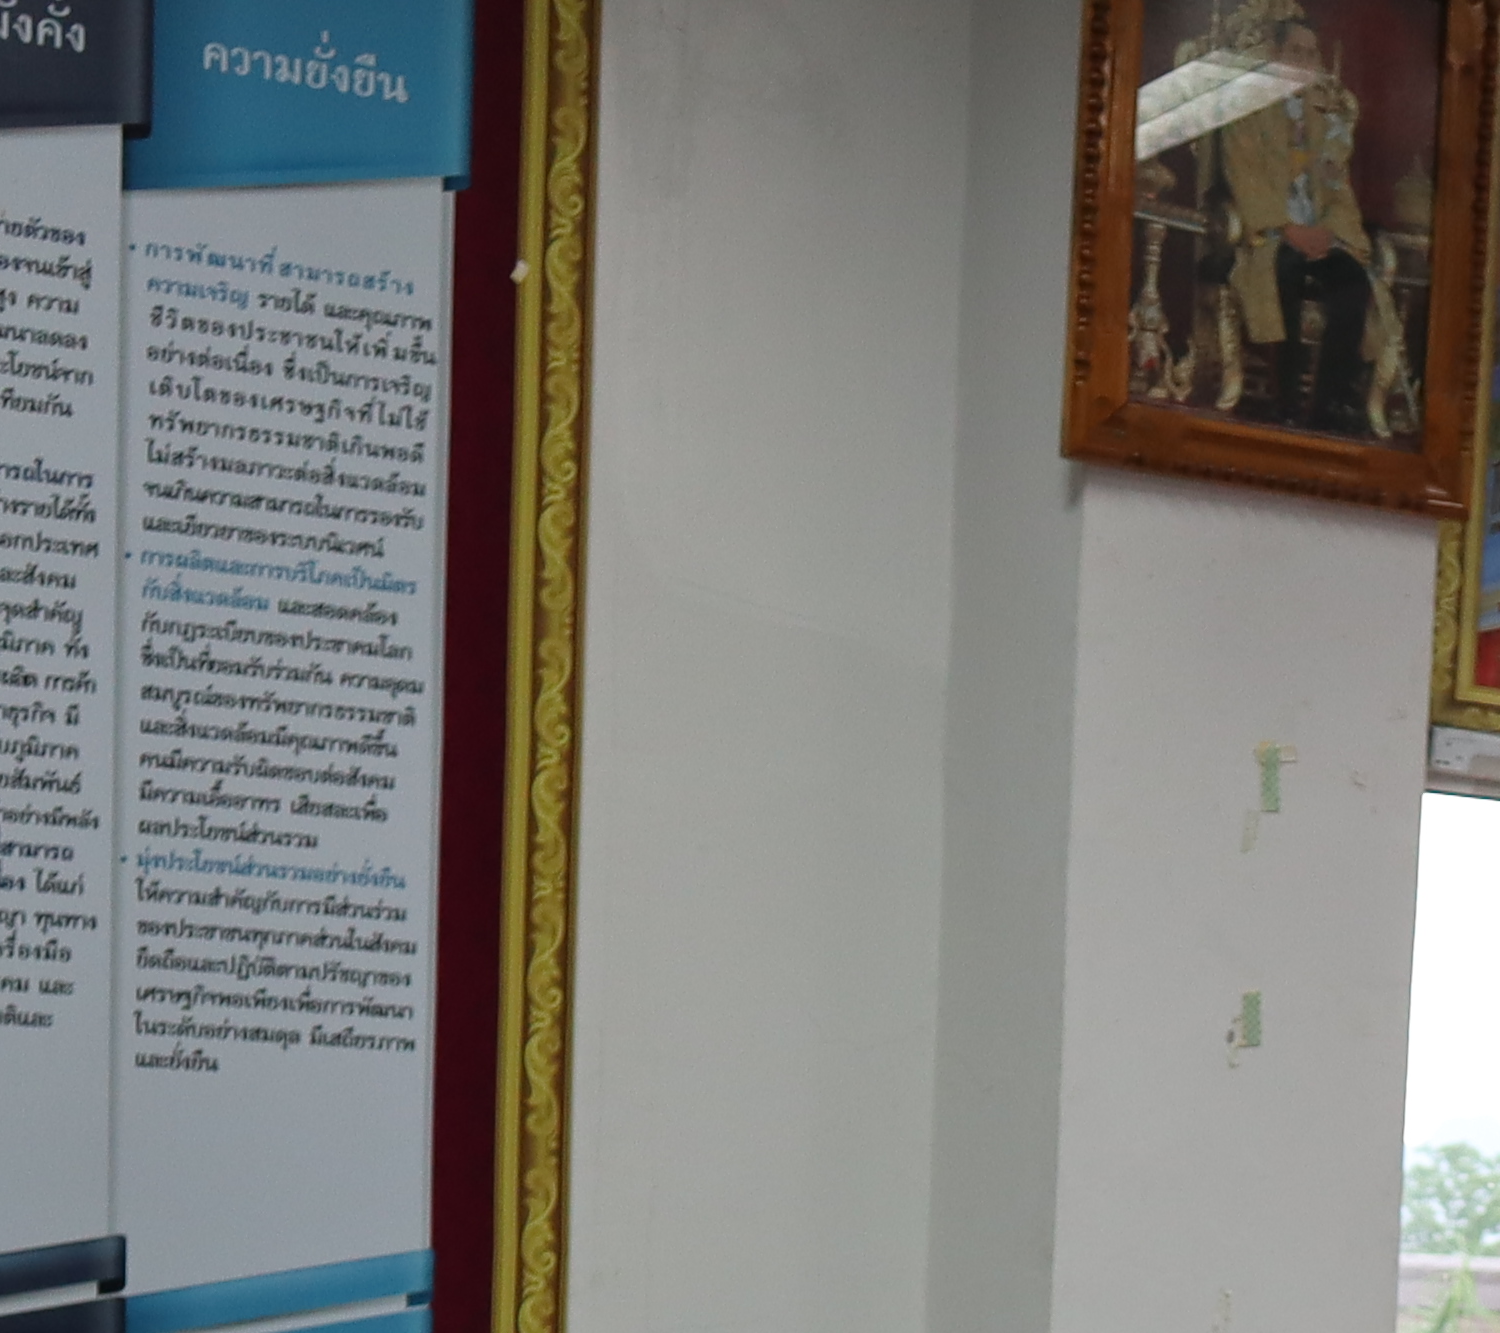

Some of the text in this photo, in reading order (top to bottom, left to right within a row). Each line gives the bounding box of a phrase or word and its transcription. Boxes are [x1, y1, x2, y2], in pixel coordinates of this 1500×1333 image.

[203, 31, 409, 103] ความยั่งยืน
